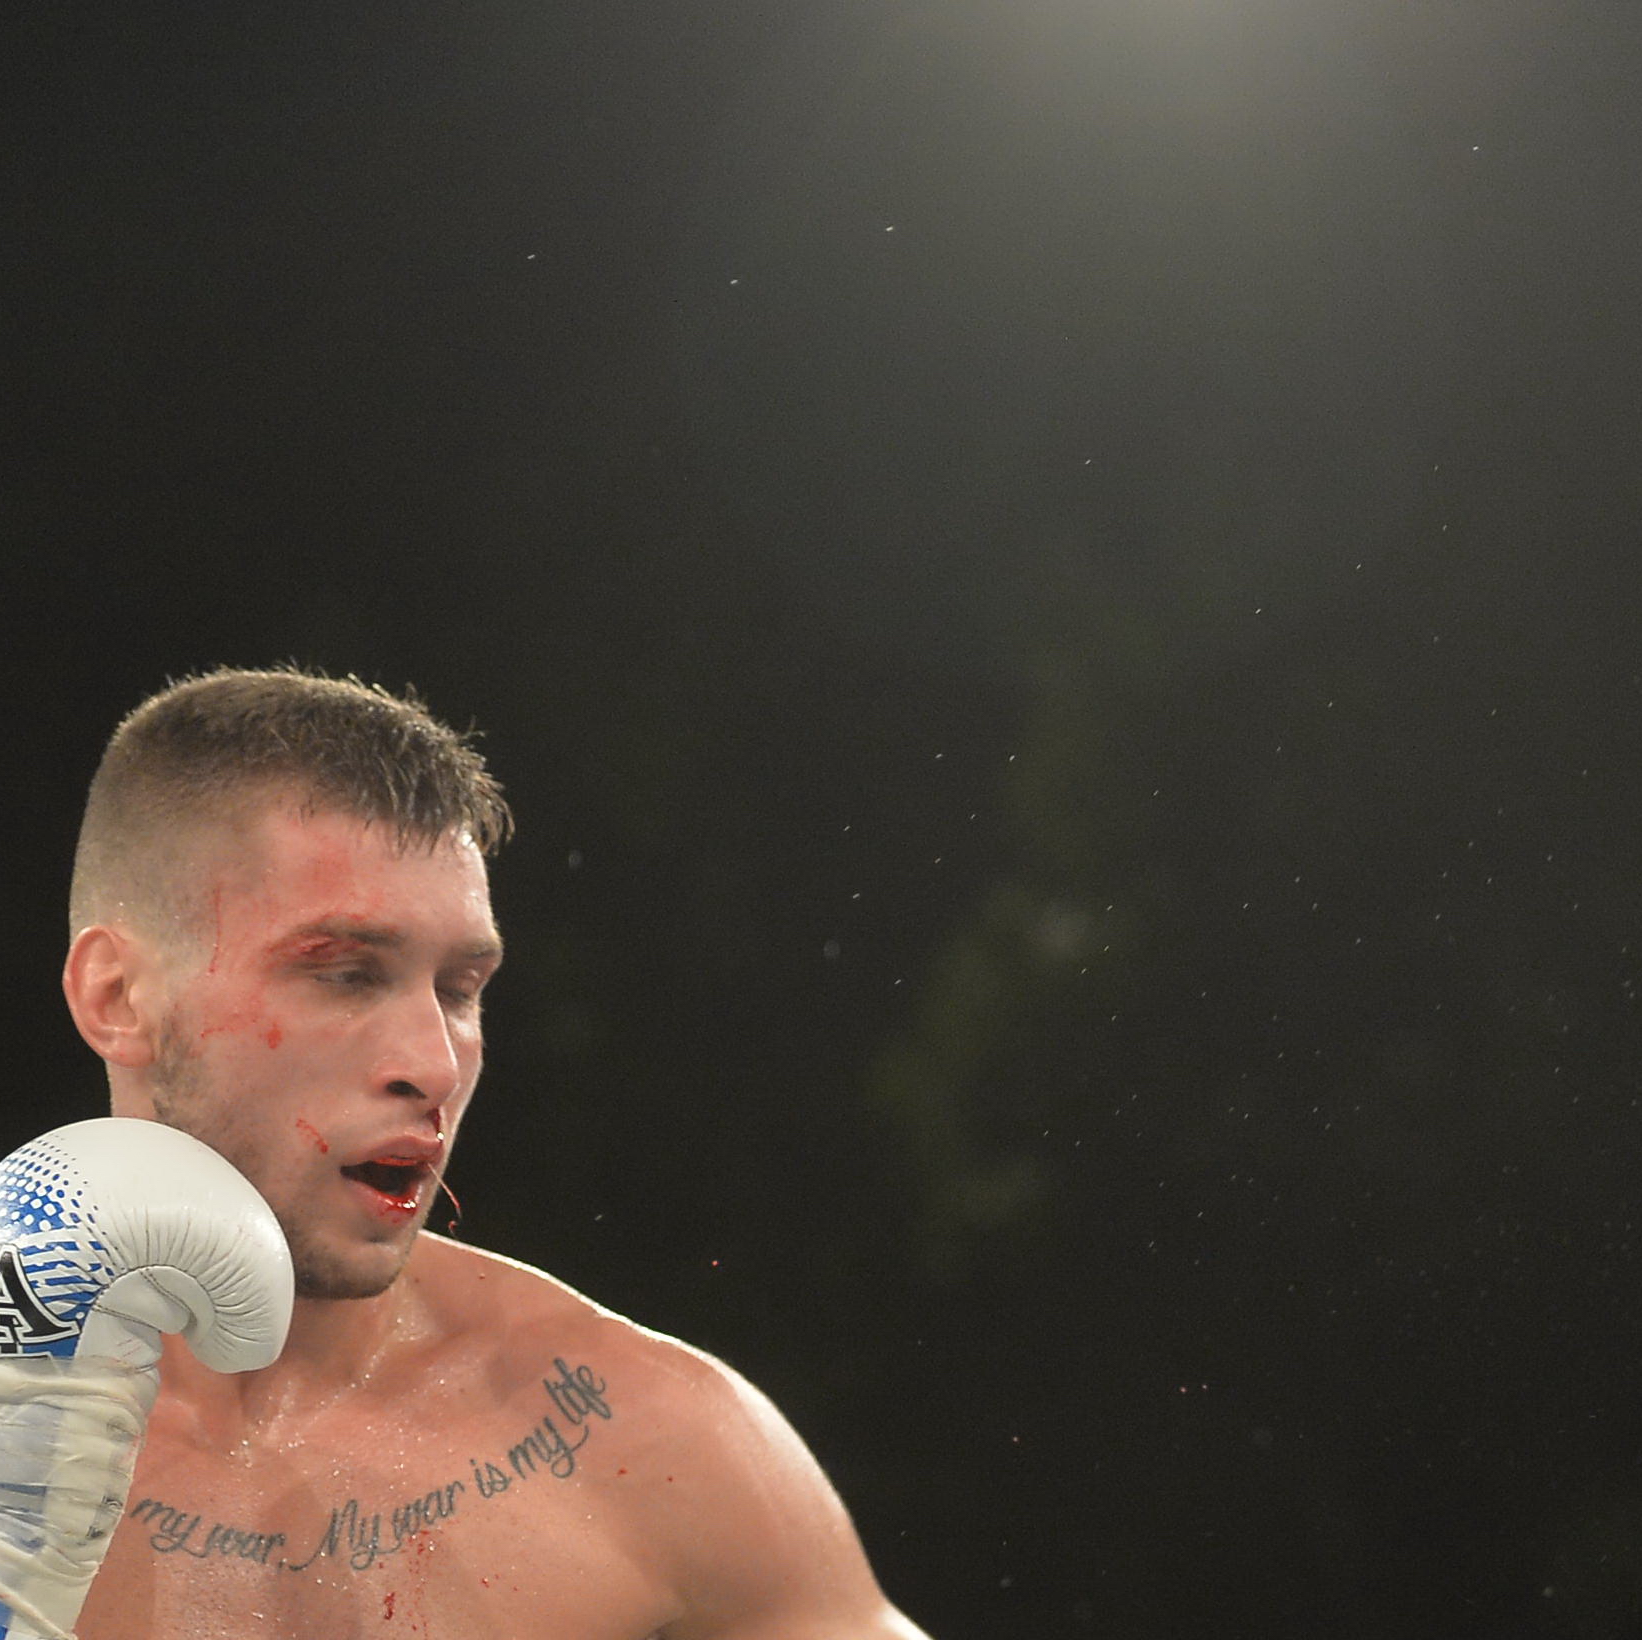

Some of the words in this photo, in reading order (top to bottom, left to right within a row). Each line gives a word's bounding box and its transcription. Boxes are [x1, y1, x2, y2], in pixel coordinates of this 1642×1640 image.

[543, 1358, 611, 1425] life
[508, 1413, 589, 1478] my
[469, 1458, 512, 1498] is
[392, 1480, 465, 1541] war
